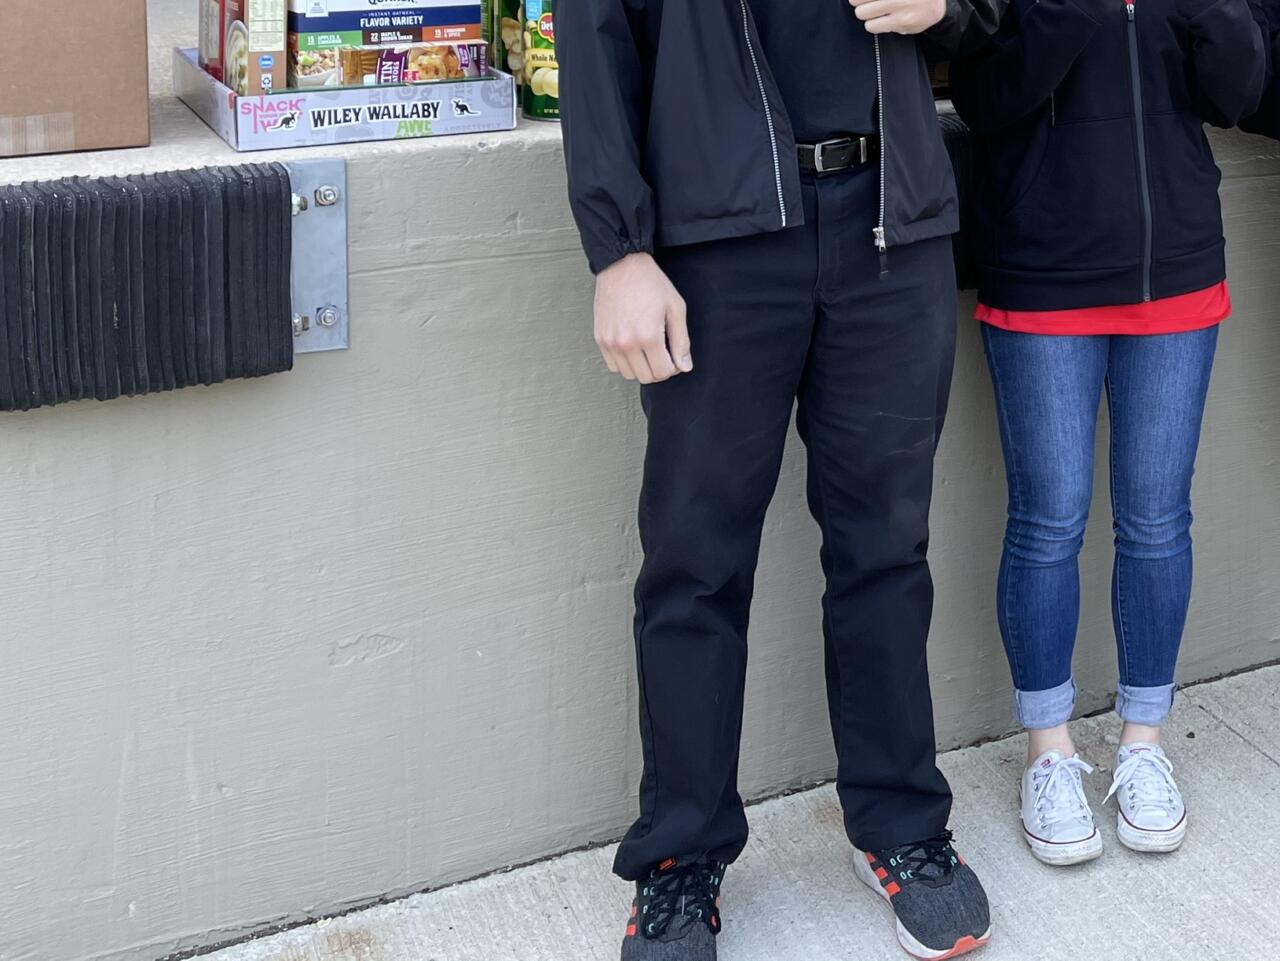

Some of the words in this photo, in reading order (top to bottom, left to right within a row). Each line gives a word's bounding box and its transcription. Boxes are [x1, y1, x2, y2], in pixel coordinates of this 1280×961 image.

[360, 17, 390, 28] FLAVOR
[391, 15, 424, 26] VARIETY
[531, 53, 547, 61] Whole
[311, 107, 362, 127] WILEY
[368, 101, 441, 121] WALLABY
[396, 120, 433, 133] AWE
